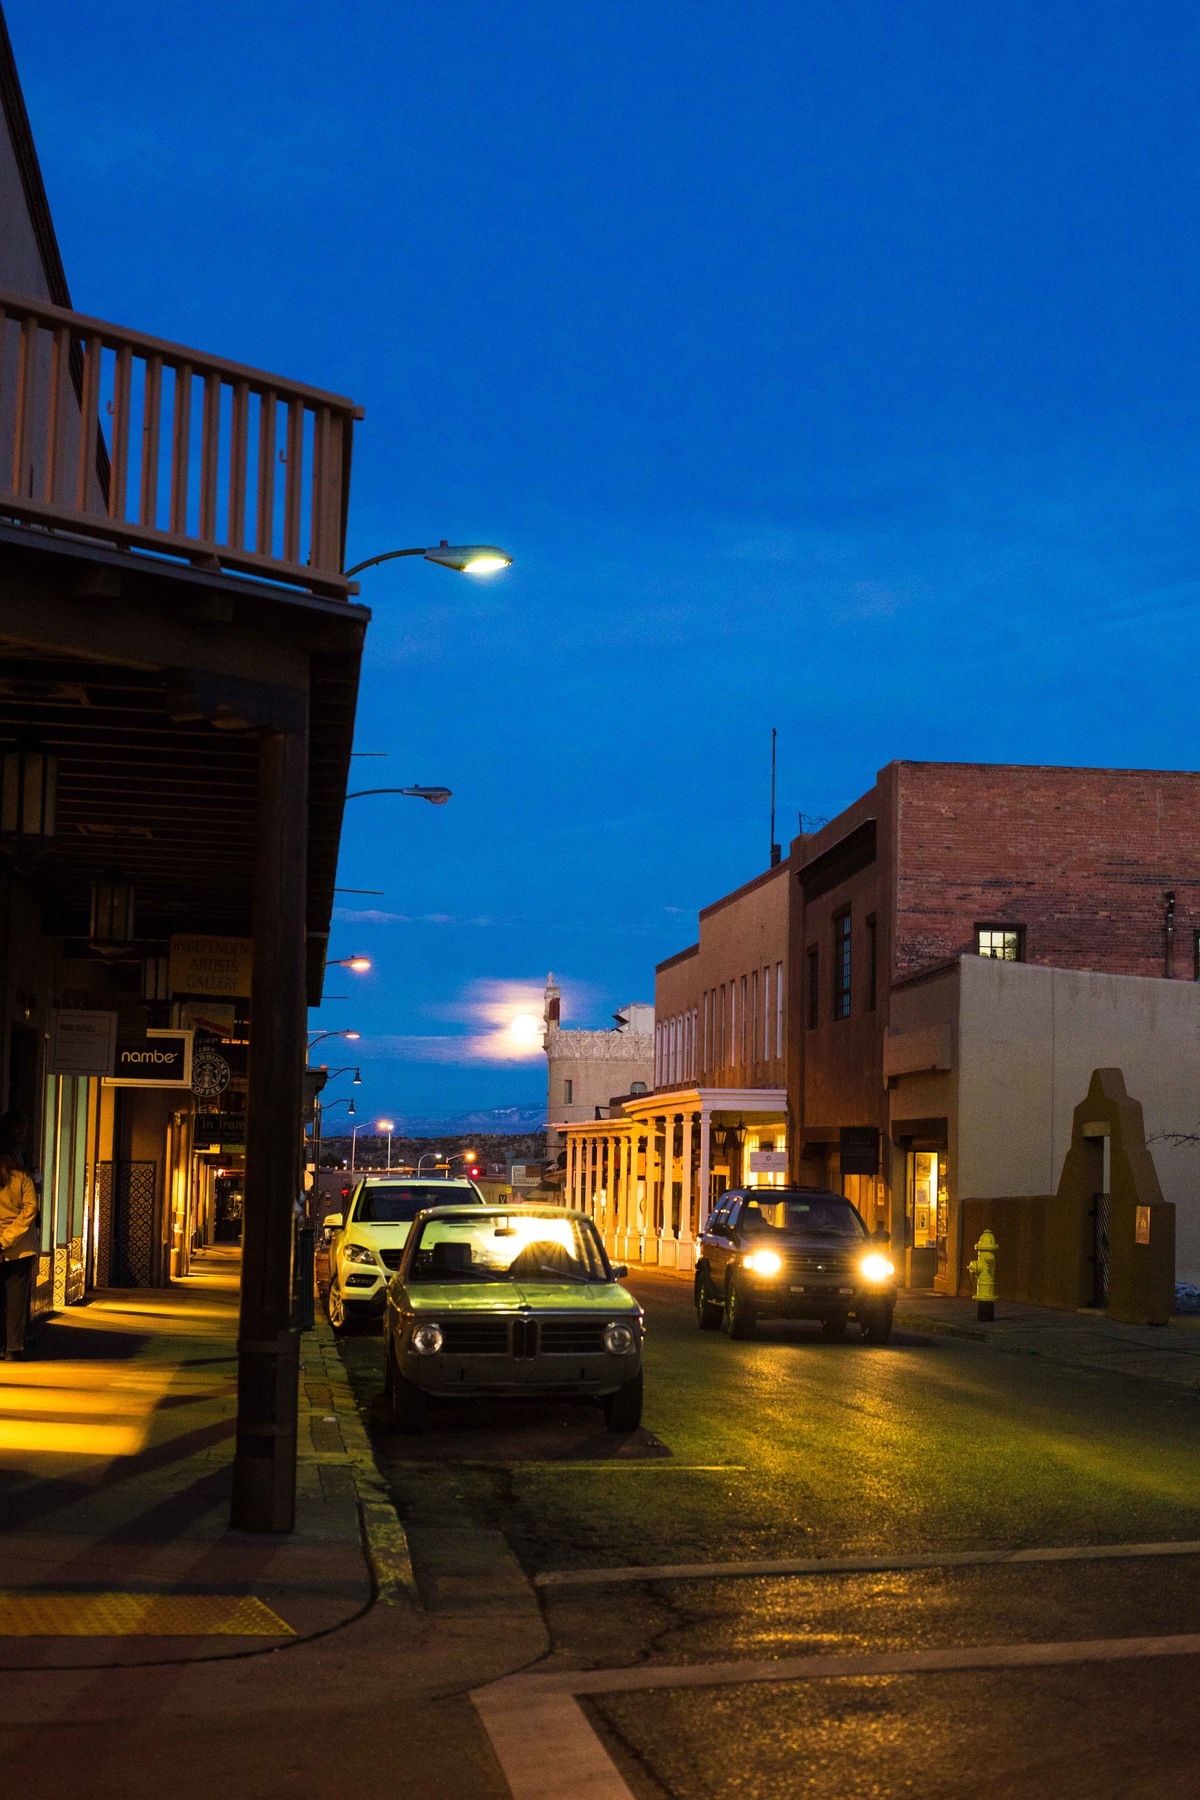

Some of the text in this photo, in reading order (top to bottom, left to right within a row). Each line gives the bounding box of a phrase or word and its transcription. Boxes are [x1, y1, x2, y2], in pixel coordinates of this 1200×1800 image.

[174, 939, 249, 955] INDEPENDEN
[190, 958, 239, 973] ARTISTS
[186, 975, 238, 990] GALLERY
